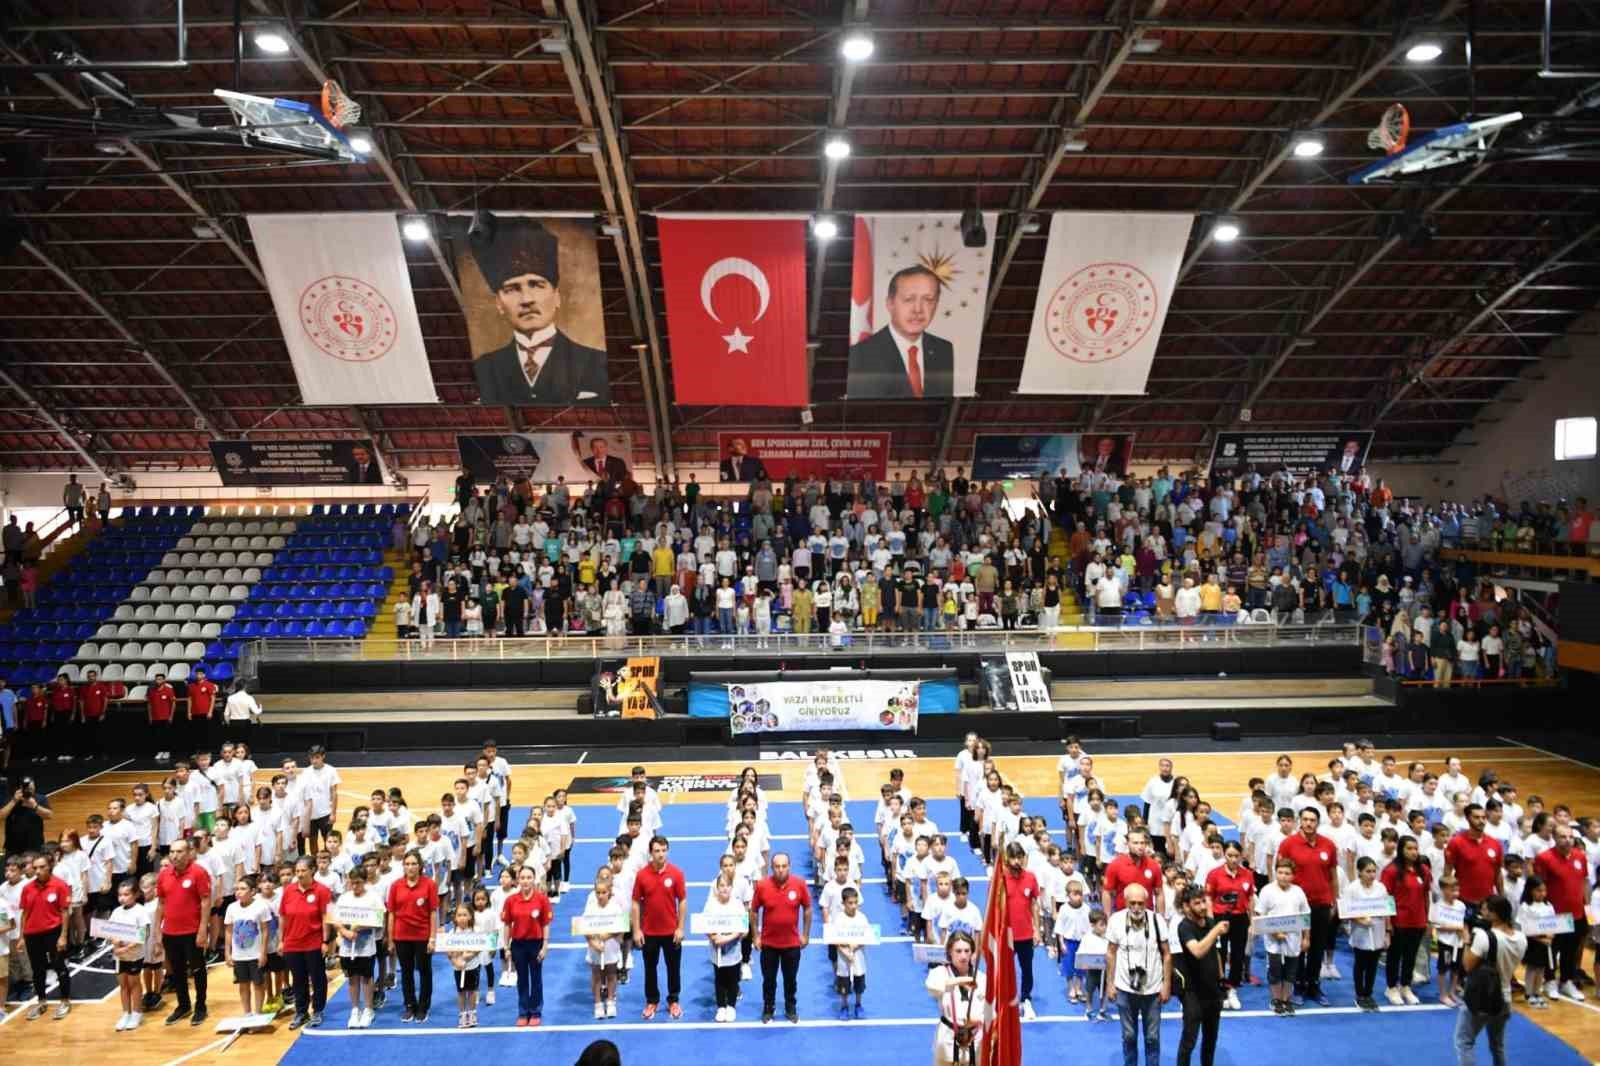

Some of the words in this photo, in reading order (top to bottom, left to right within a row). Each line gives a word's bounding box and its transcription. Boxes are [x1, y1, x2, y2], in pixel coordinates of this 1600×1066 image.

[630, 665, 655, 677] SPOR
[1011, 660, 1037, 672] SPOR
[1015, 674, 1029, 686] LA
[784, 695, 808, 705] YAZA
[760, 748, 917, 760] BALKESİR
